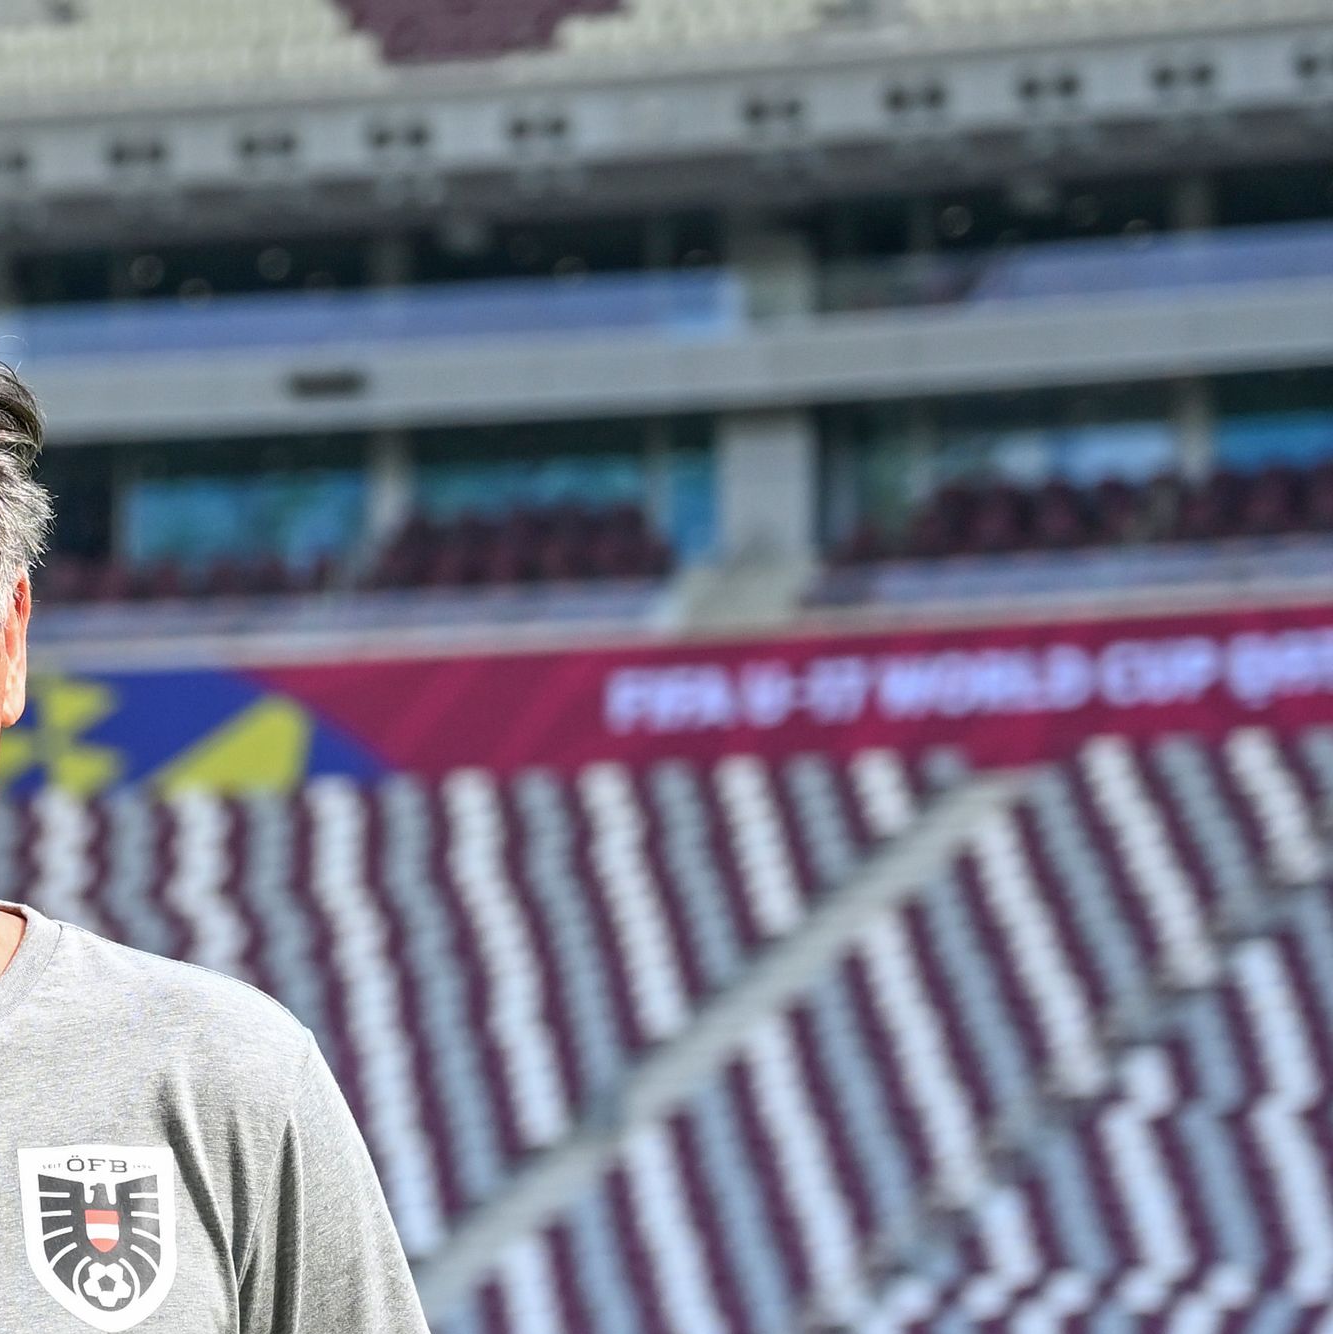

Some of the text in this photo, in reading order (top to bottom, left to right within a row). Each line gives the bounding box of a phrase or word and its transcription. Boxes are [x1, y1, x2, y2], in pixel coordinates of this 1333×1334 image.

[604, 663, 734, 736] FIFA
[738, 657, 867, 728] U-17
[877, 643, 1090, 722] WORLD
[1098, 635, 1219, 708] CUP
[66, 1154, 128, 1173] ÖFB
